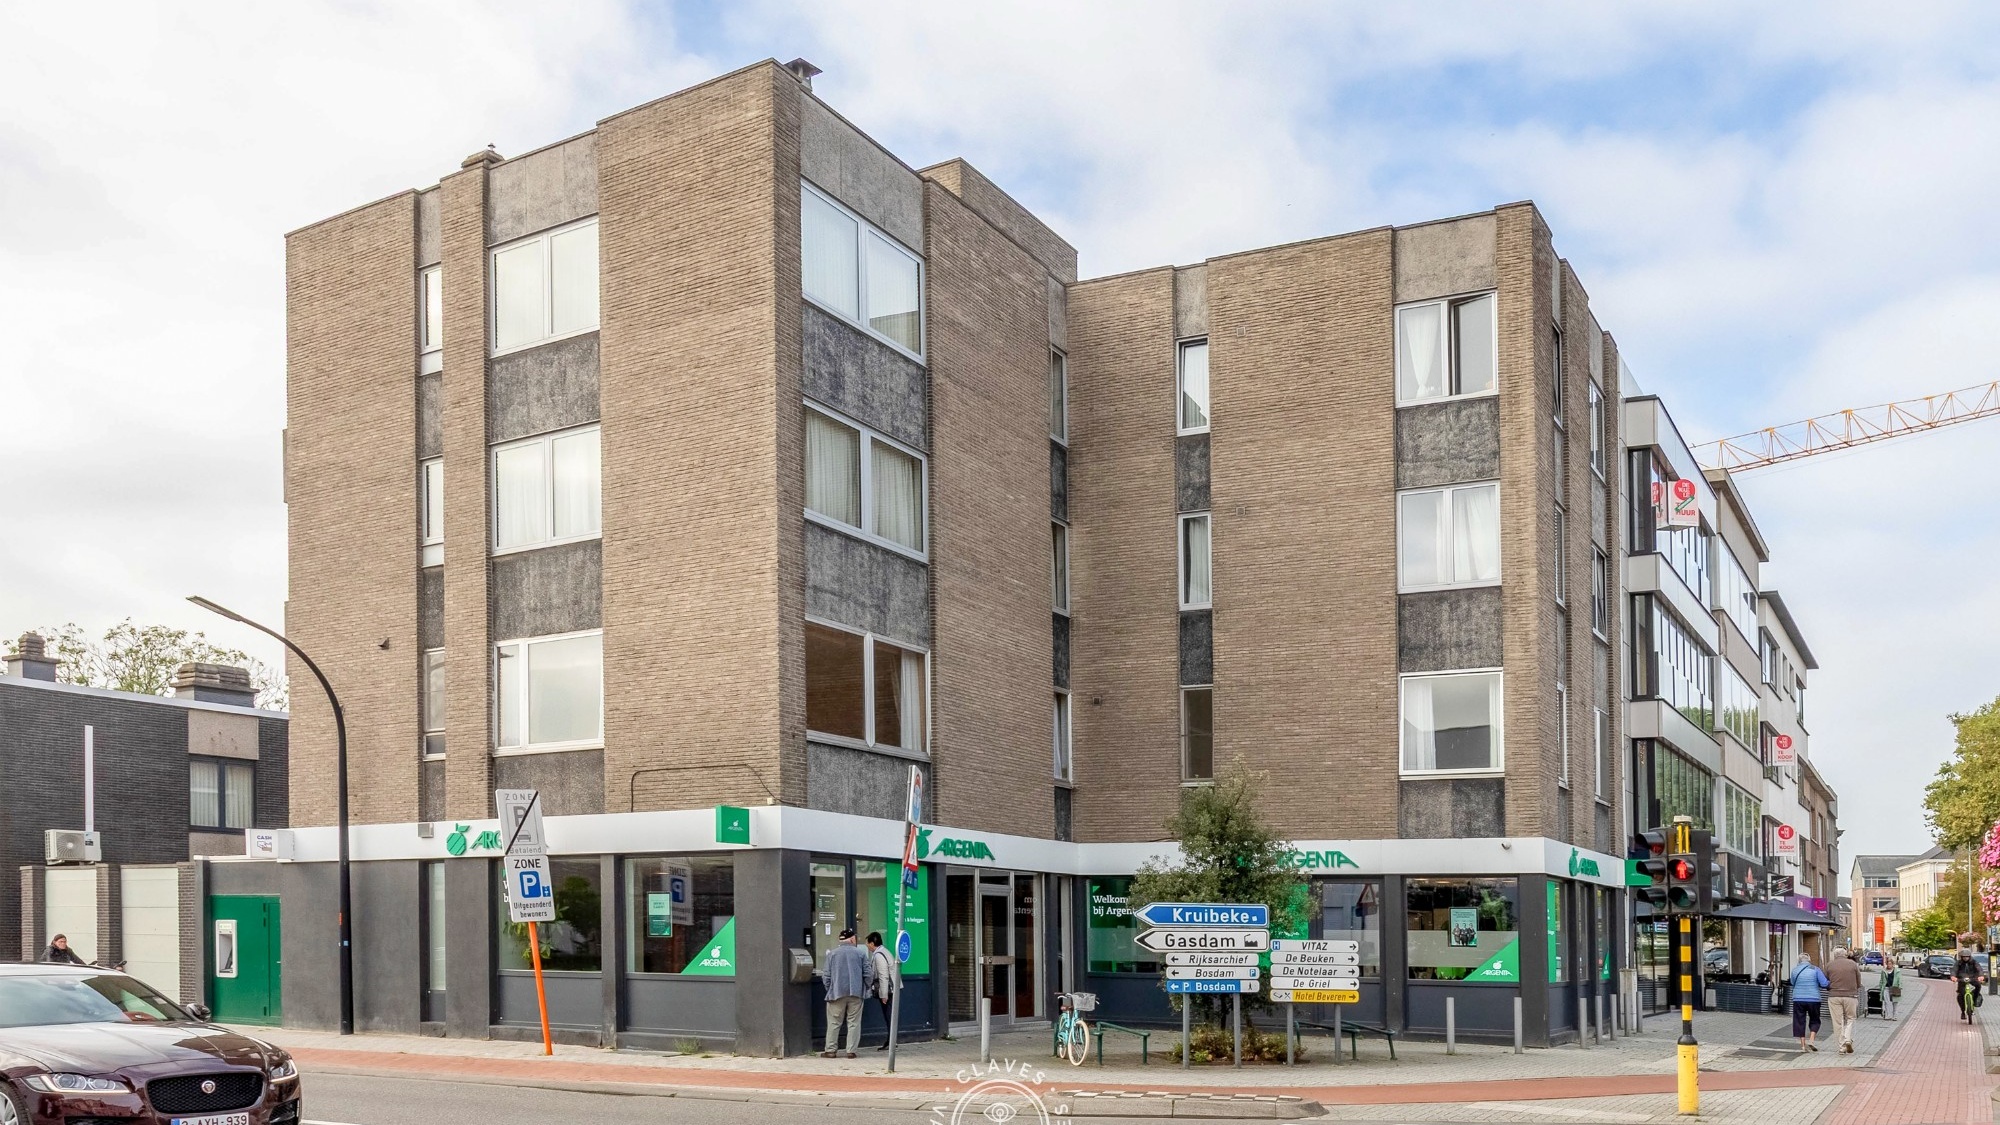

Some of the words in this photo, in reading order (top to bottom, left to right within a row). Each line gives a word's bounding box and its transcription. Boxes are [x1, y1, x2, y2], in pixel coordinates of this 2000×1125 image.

[504, 793, 533, 801] ZONE
[469, 830, 502, 851] ARG
[508, 846, 542, 854] Betalend
[932, 837, 996, 861] ARGENTA
[513, 858, 542, 869] ZONE
[1276, 850, 1360, 869] RGENTA
[522, 874, 537, 896] P
[513, 900, 552, 911] Uitgezonderd
[519, 910, 548, 919] bewoners
[1093, 905, 1104, 917] bij
[1106, 906, 1136, 918] Argent
[1172, 907, 1250, 924] Kruibeke
[1164, 932, 1236, 949] Gasdam
[1300, 941, 1328, 951] VITAZ
[1188, 953, 1249, 967] Rijksarchief
[1285, 953, 1298, 964] De
[1300, 953, 1335, 964] Beuken
[1195, 968, 1235, 979] Bosdam
[1282, 966, 1295, 977] De
[1297, 966, 1338, 977] Notelaar
[1183, 981, 1190, 992] P
[1195, 981, 1236, 992] Bosdam
[1292, 978, 1305, 989] De
[1308, 978, 1331, 989] Griel
[1294, 991, 1315, 1002] Hotel
[1316, 991, 1347, 1002] Beveren
